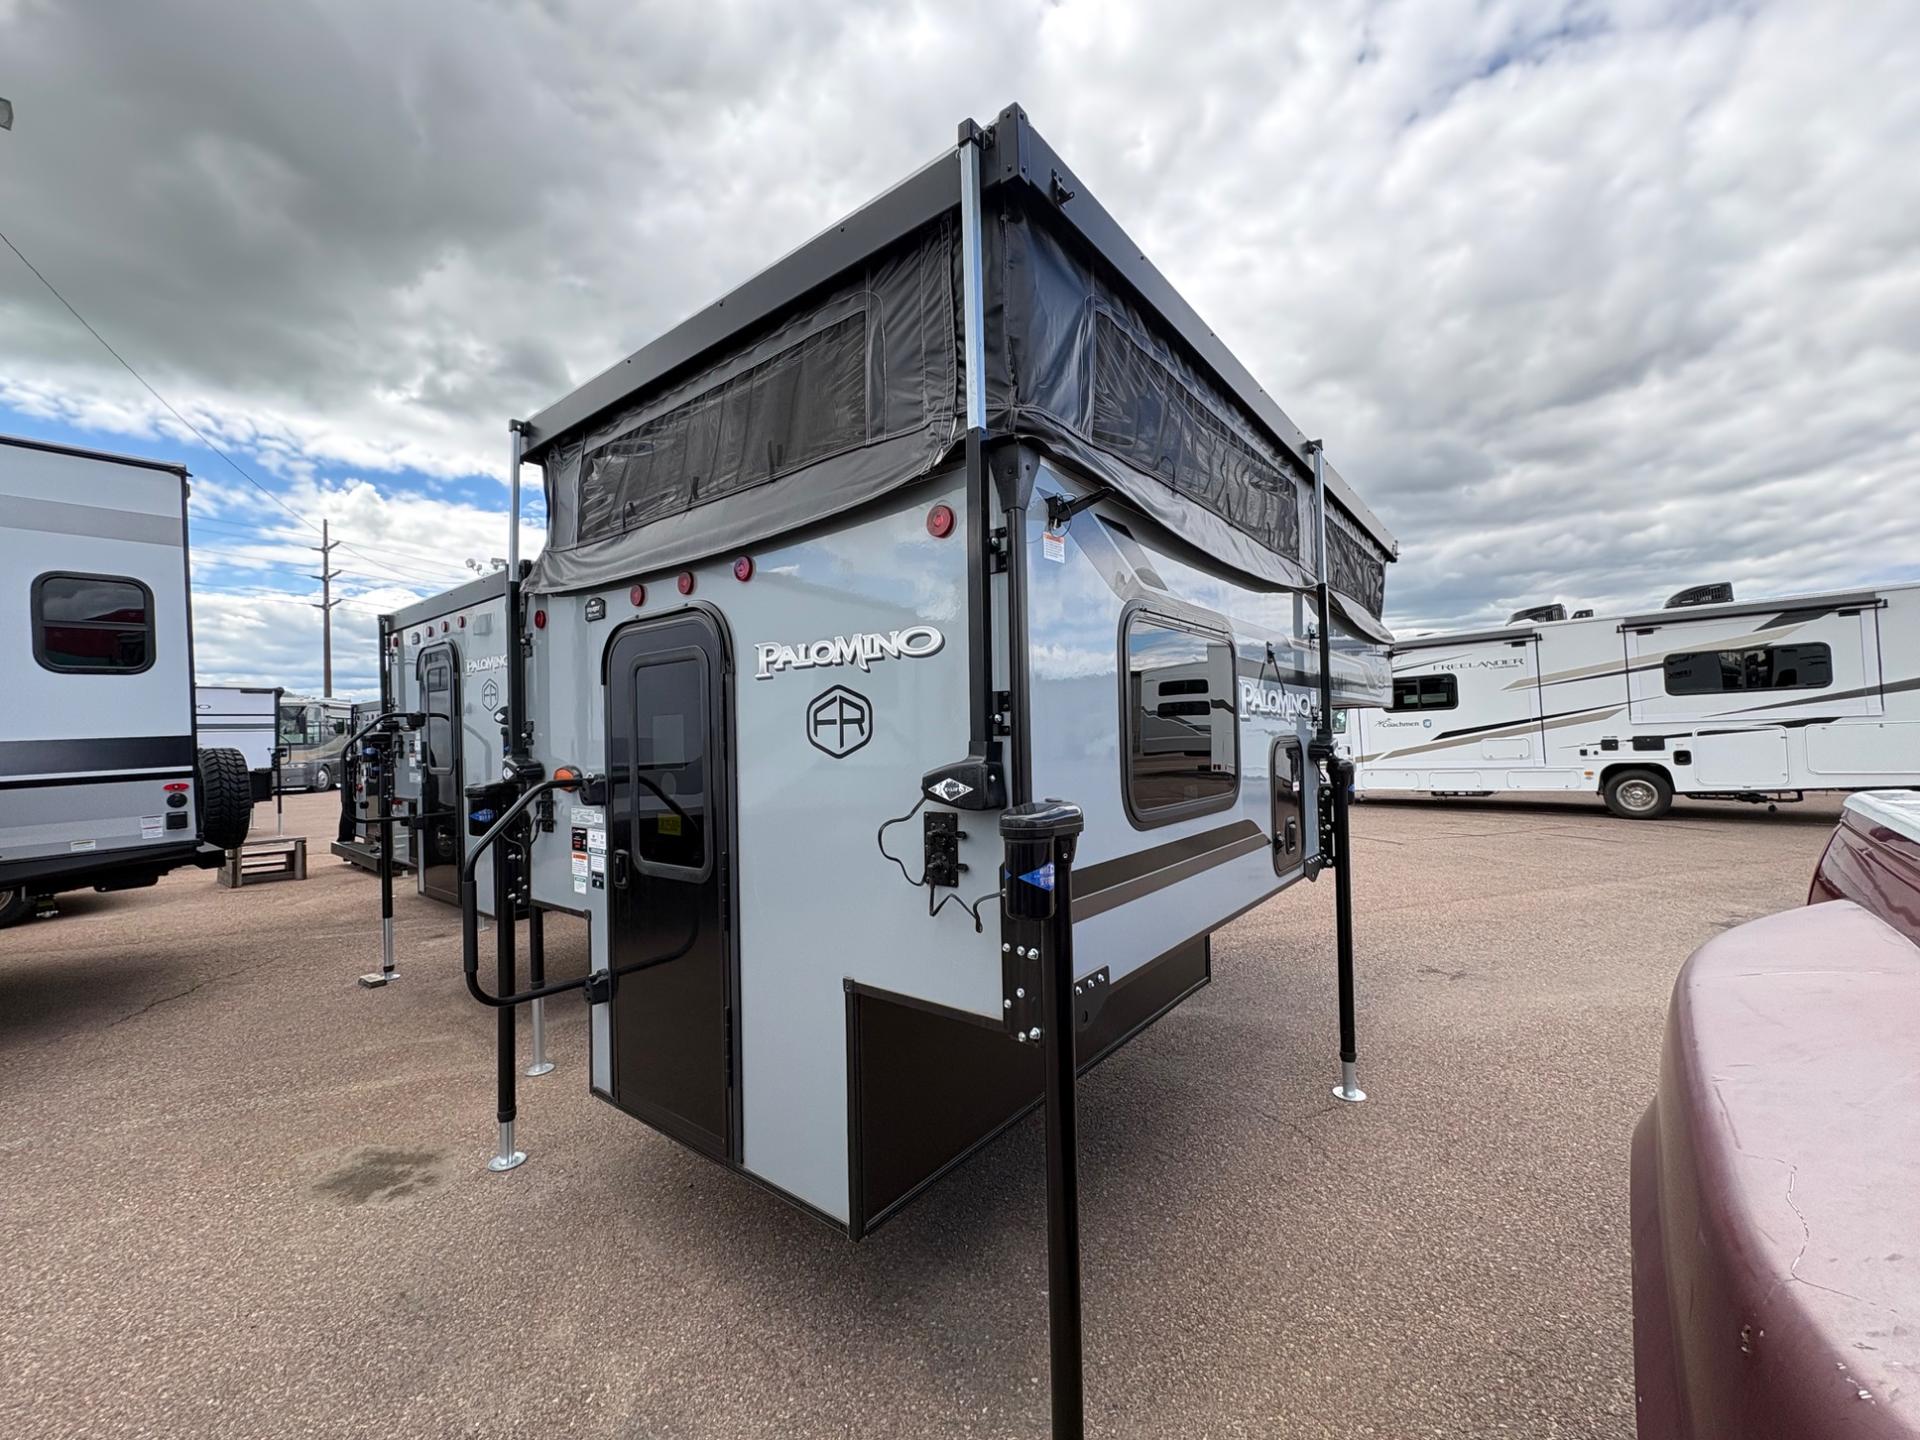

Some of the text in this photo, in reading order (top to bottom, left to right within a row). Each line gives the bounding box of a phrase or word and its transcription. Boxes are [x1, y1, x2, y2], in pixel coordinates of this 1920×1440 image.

[754, 626, 945, 680] PALOMINO
[1433, 658, 1525, 671] FREELANDER
[1238, 679, 1312, 725] PALOMINO
[1382, 719, 1420, 728] Coachmen
